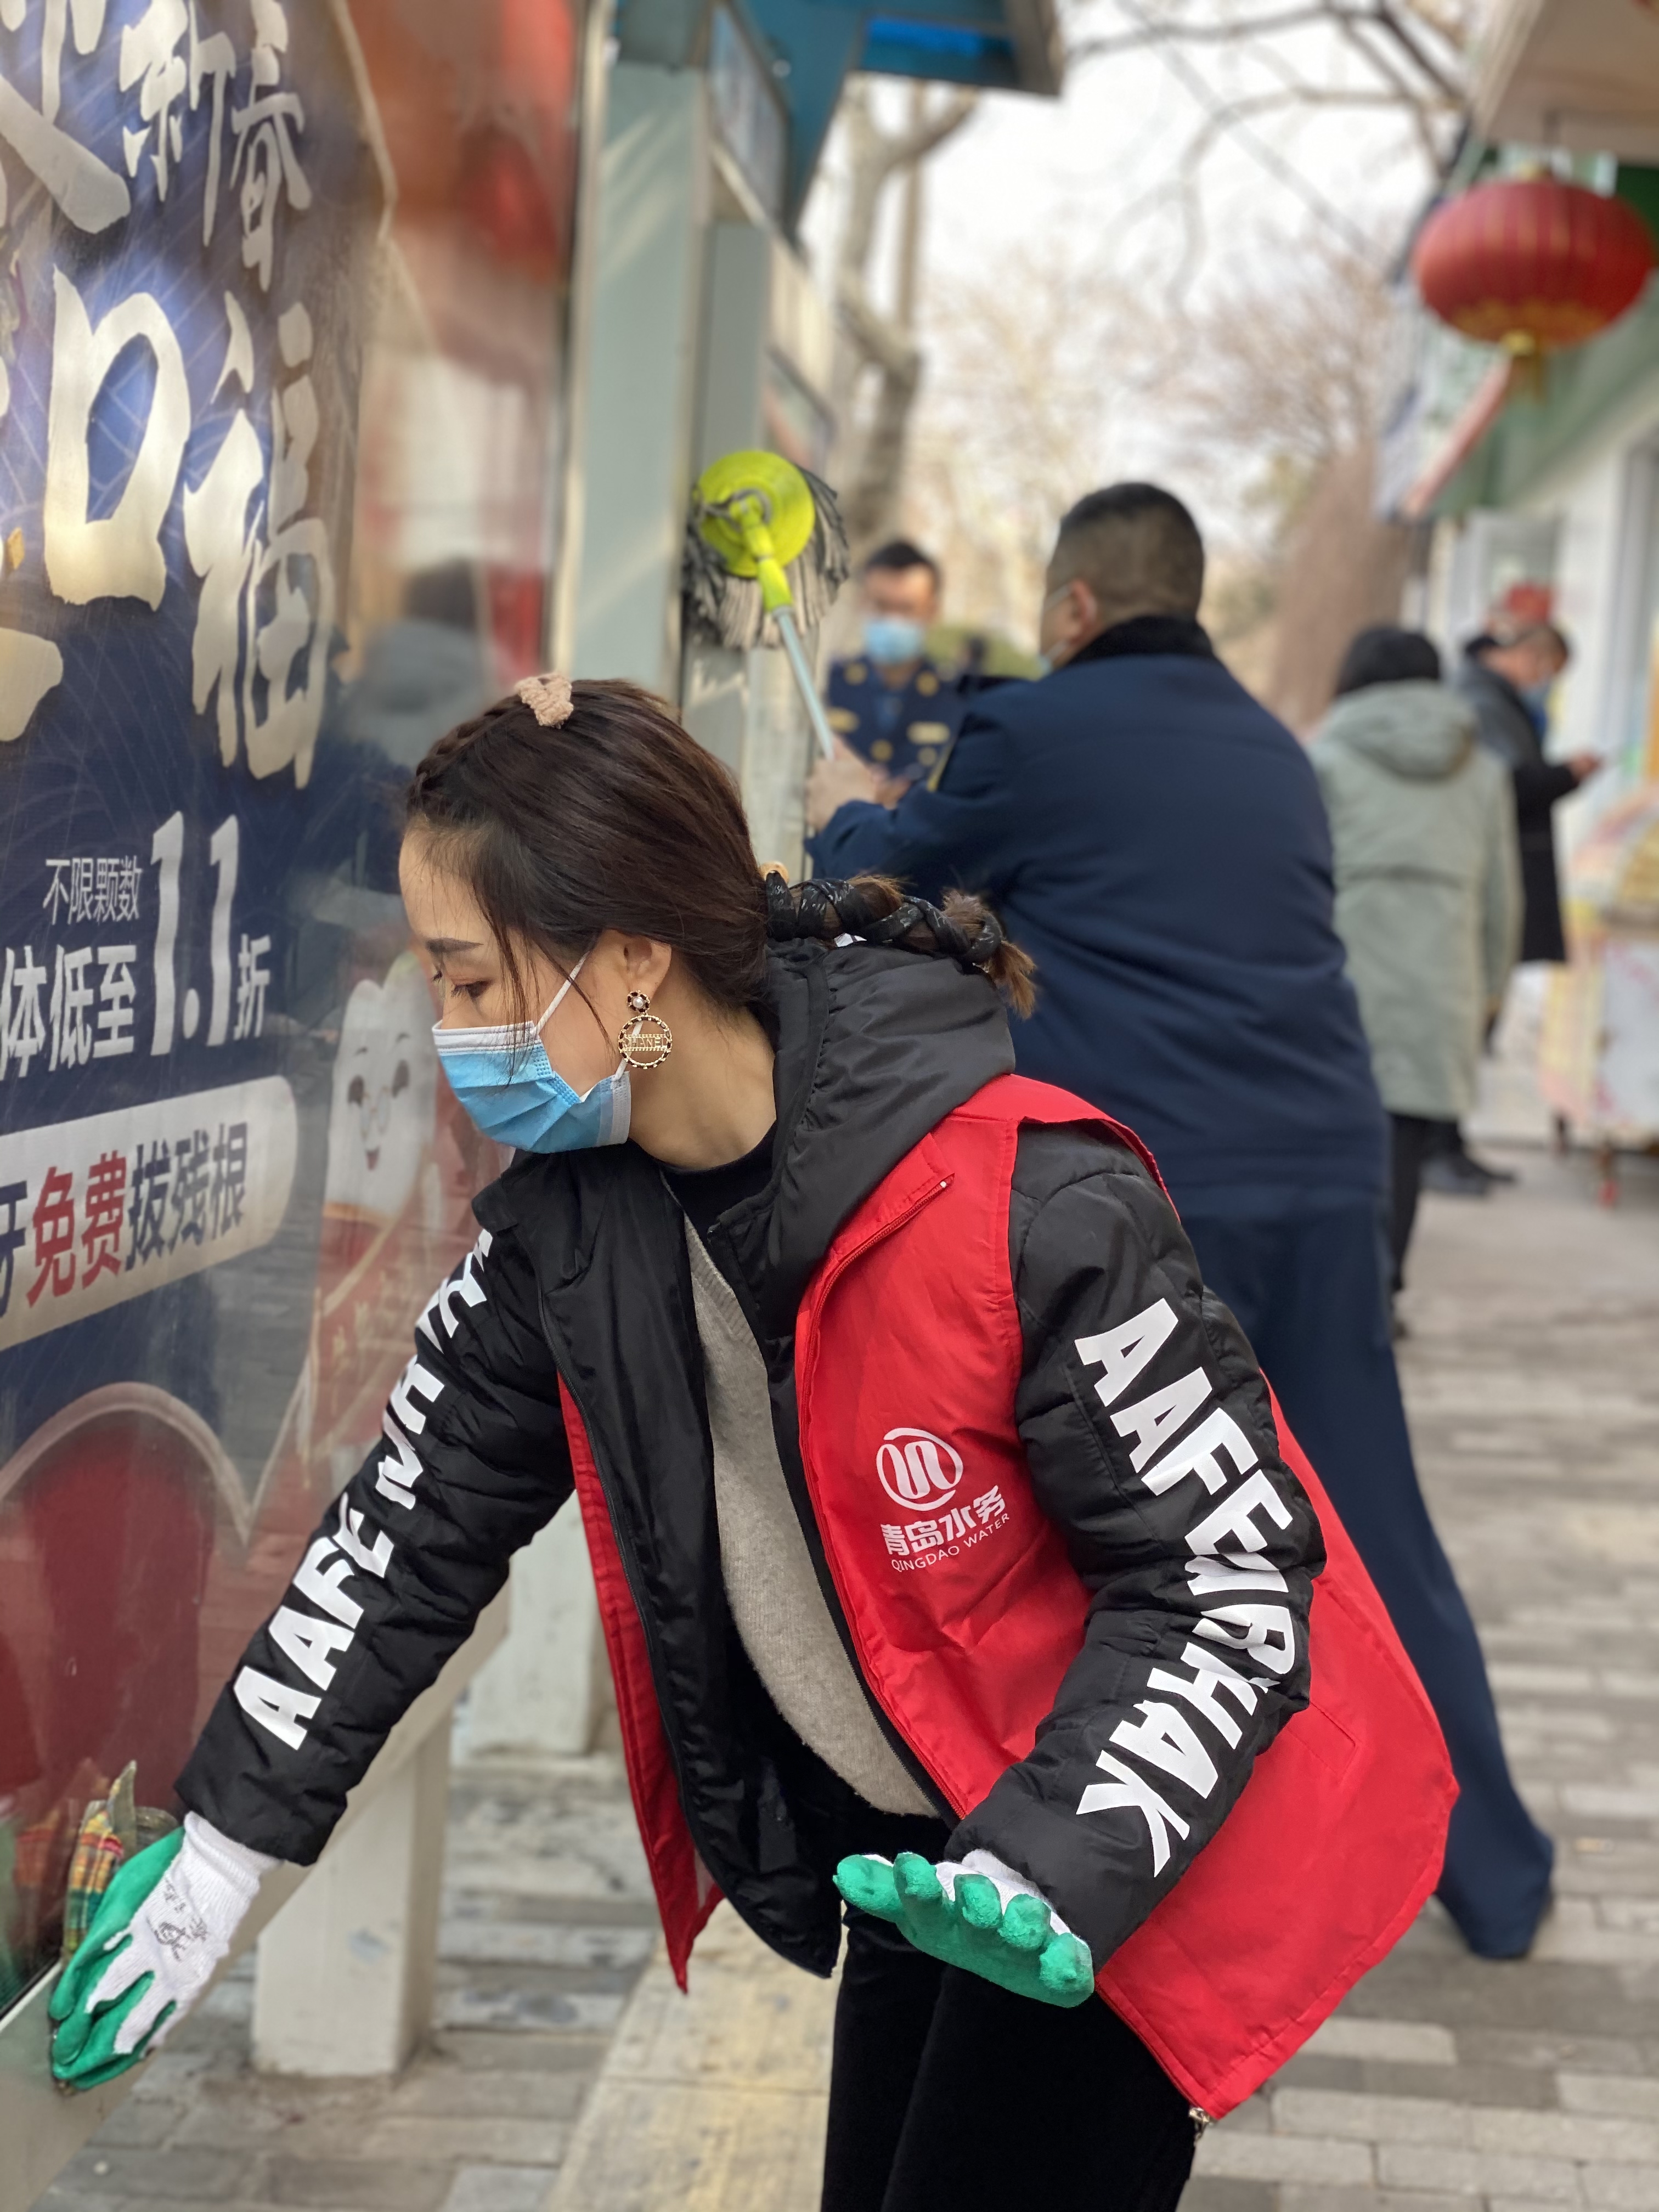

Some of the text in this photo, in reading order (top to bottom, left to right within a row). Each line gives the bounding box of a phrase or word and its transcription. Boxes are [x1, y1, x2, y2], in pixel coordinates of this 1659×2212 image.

[0, 263, 336, 790] 口福
[42, 855, 143, 925] 不限颗数
[880, 1485, 1006, 1556] 青岛水务
[891, 1513, 1010, 1573] QINGDAO WATER
